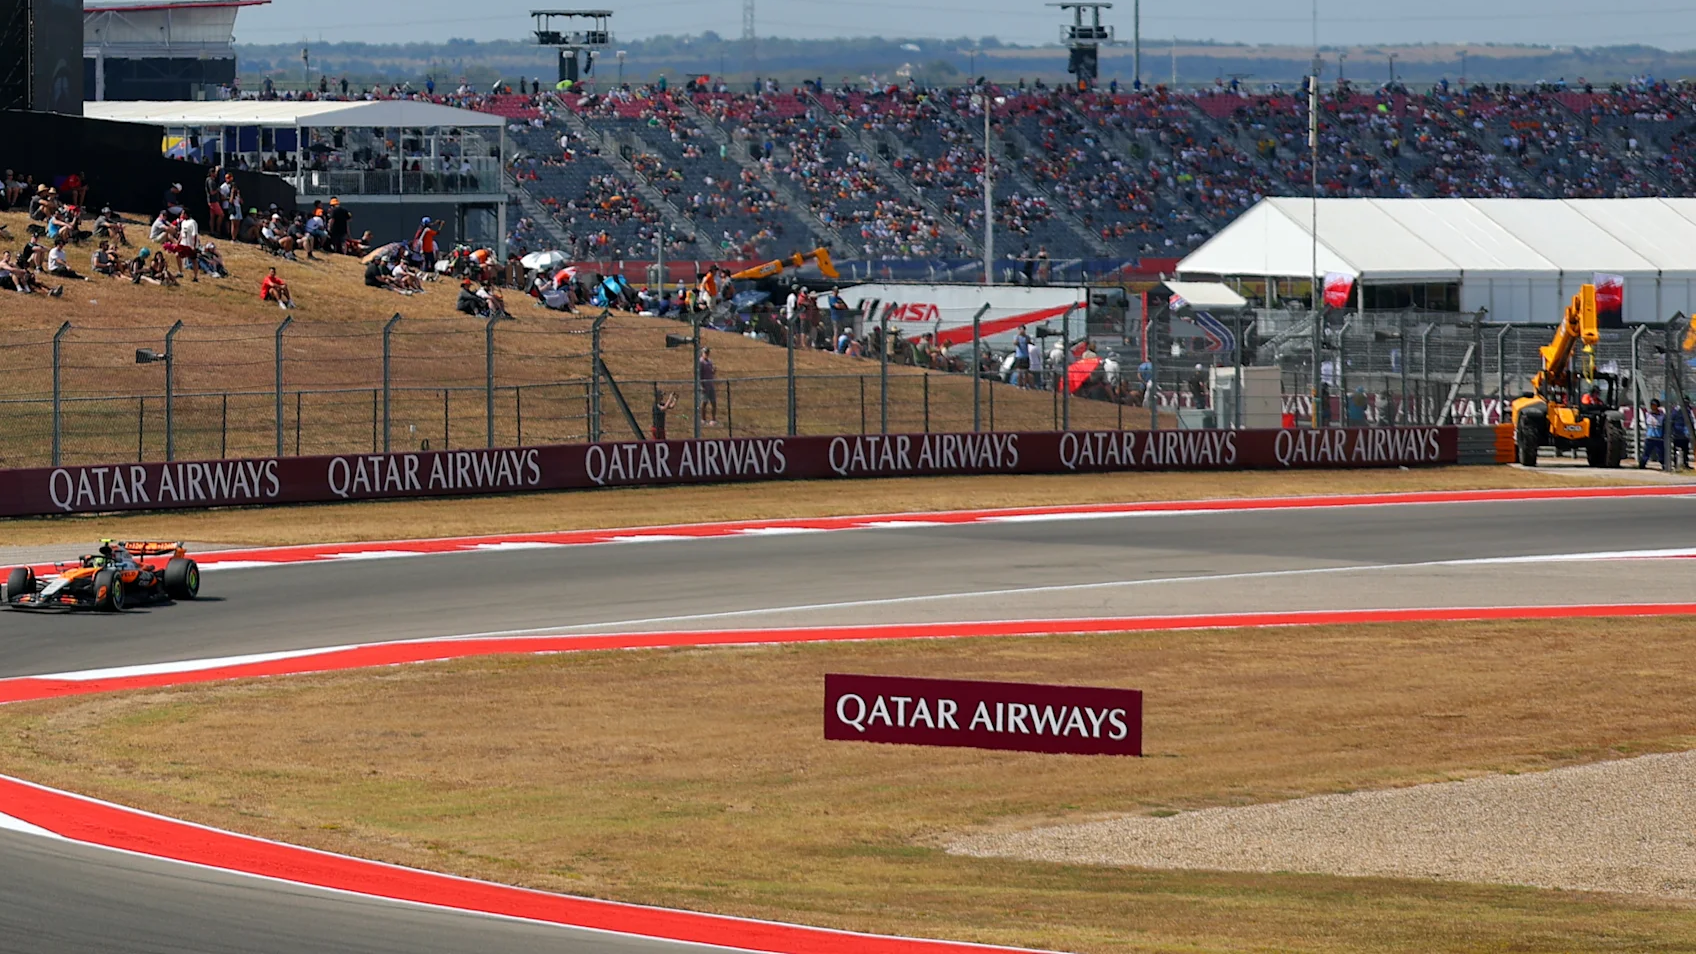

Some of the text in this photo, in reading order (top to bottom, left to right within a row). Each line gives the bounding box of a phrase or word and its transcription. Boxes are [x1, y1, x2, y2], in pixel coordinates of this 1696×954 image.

[586, 439, 785, 484] QATAR AIRWAYS
[829, 434, 1017, 474] QATAR AIRWAYS
[1060, 431, 1235, 468] QATAR AIRWAYS
[1275, 428, 1439, 465] QATAR AIRWAYS
[50, 460, 279, 510] QATAR AIRWAYS
[329, 450, 540, 497] QATAR AIRWAYS
[836, 693, 1128, 740] QATAR AIRWAYS
